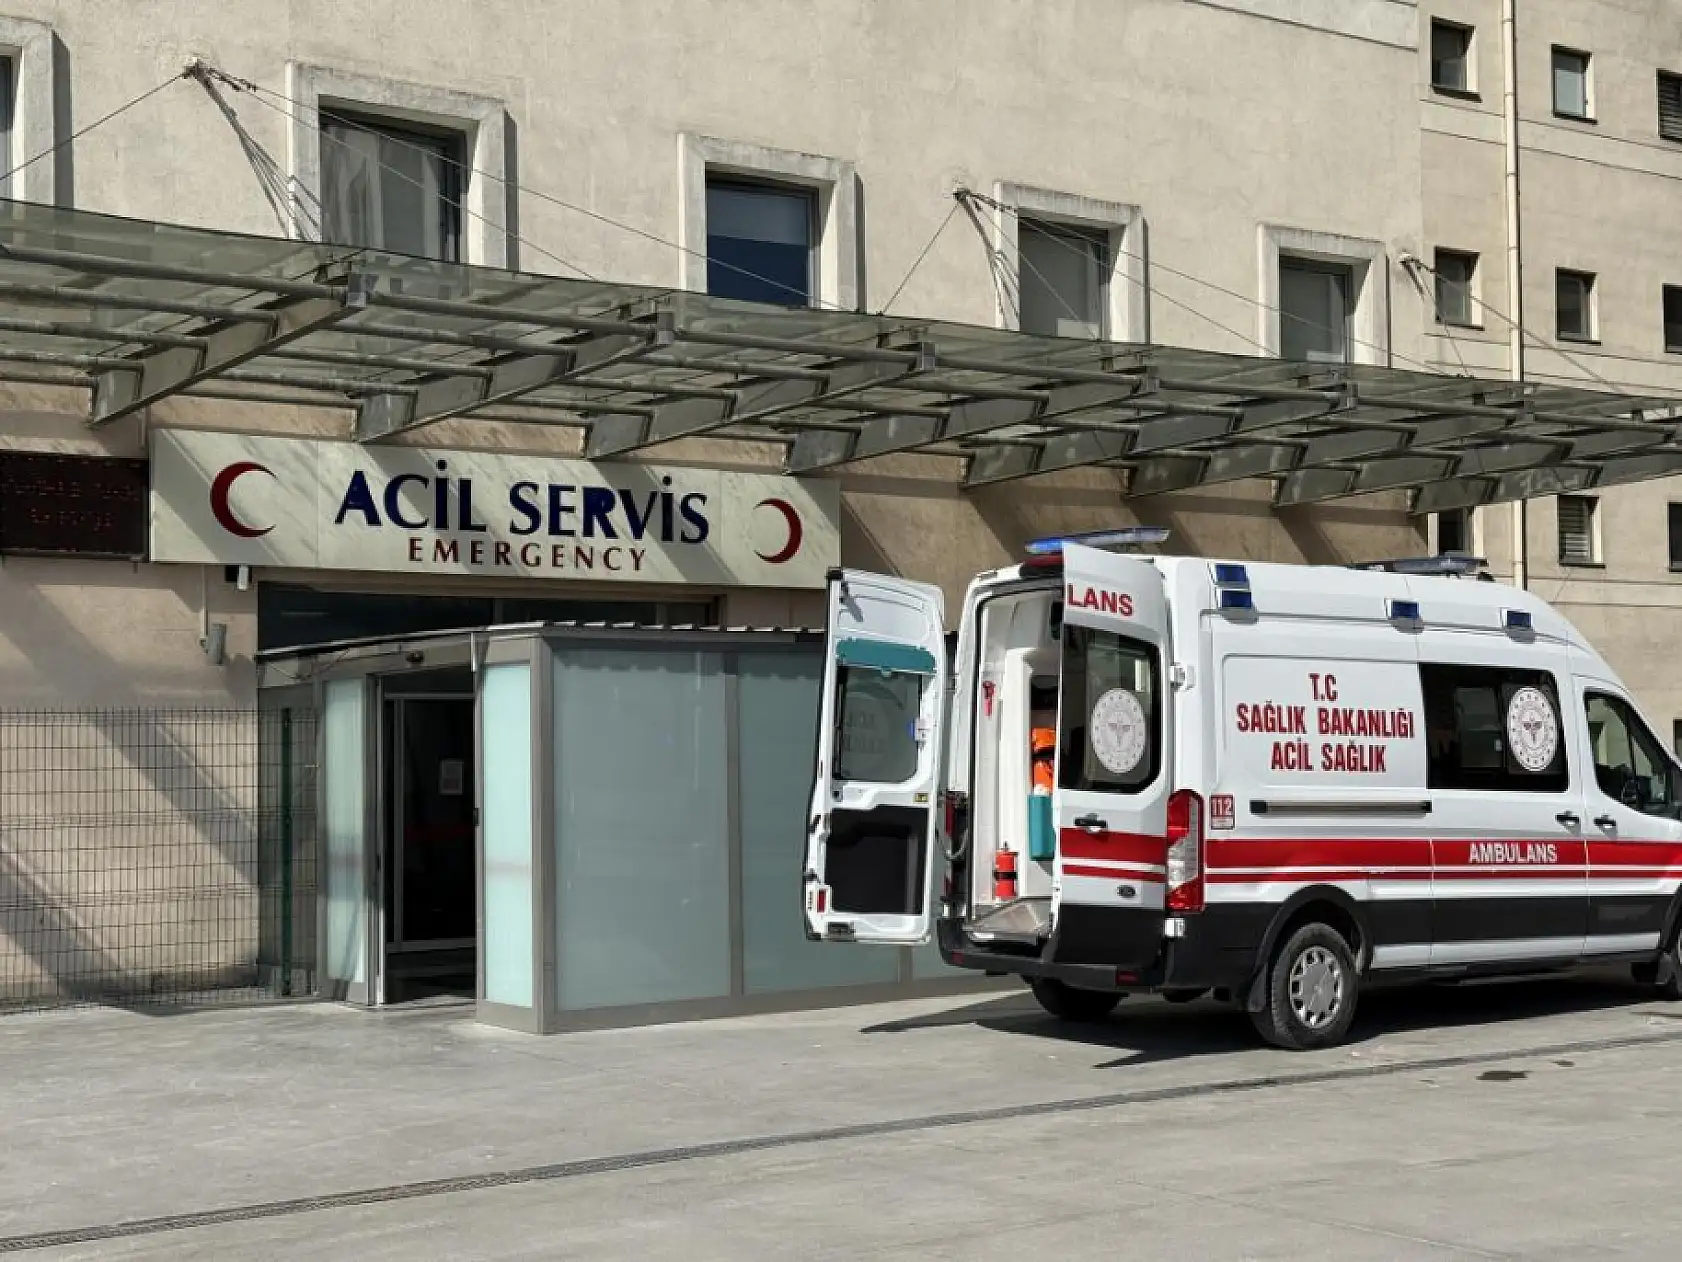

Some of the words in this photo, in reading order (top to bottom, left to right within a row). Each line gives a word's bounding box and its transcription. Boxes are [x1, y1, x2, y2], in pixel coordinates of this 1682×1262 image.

[335, 459, 487, 533] ACİL
[509, 475, 710, 545] SERVİS
[408, 536, 648, 572] EMERGENCY
[1067, 583, 1133, 616] LANS
[1308, 672, 1339, 702] T.C
[1236, 699, 1307, 734] SAĞLIK
[1317, 706, 1416, 739] BAKANLIĞI
[1270, 737, 1314, 772] ACİL
[1320, 738, 1387, 773] SAĞLIK
[1211, 796, 1232, 816] 112
[1468, 841, 1558, 864] AMBULANS
